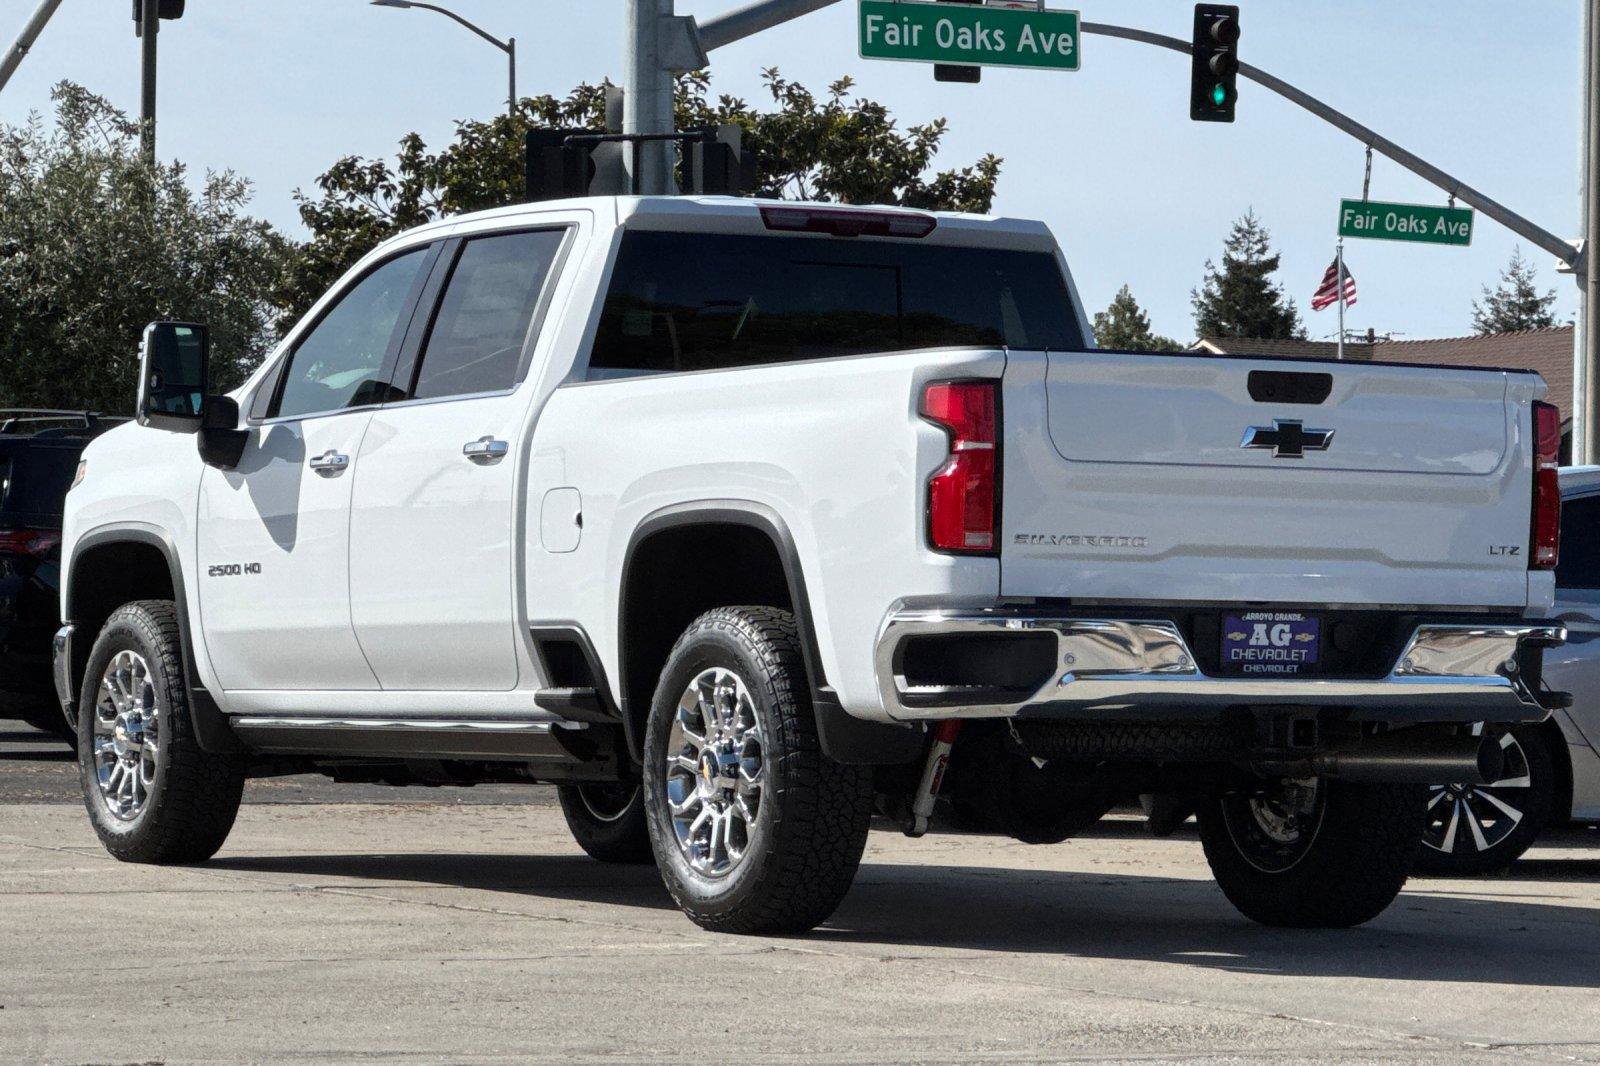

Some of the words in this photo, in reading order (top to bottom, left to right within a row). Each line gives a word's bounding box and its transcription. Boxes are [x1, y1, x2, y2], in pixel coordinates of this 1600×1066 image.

[866, 15, 923, 46] Fair
[935, 18, 1006, 51] Oaks
[1016, 24, 1073, 55] Ave
[1342, 209, 1378, 230] Fair
[1385, 212, 1427, 234] Oaks
[1434, 216, 1469, 236] Ave
[1013, 533, 1148, 547] SILVERADO
[1489, 545, 1521, 556] LTZ
[208, 564, 241, 577] 2500
[244, 562, 261, 574] HD
[1246, 612, 1273, 621] ARROYO
[1274, 613, 1301, 621] GRANDE
[1249, 623, 1292, 646] AG
[1231, 648, 1308, 660] CHEVROLET
[1243, 664, 1299, 673] CHEVROLET
